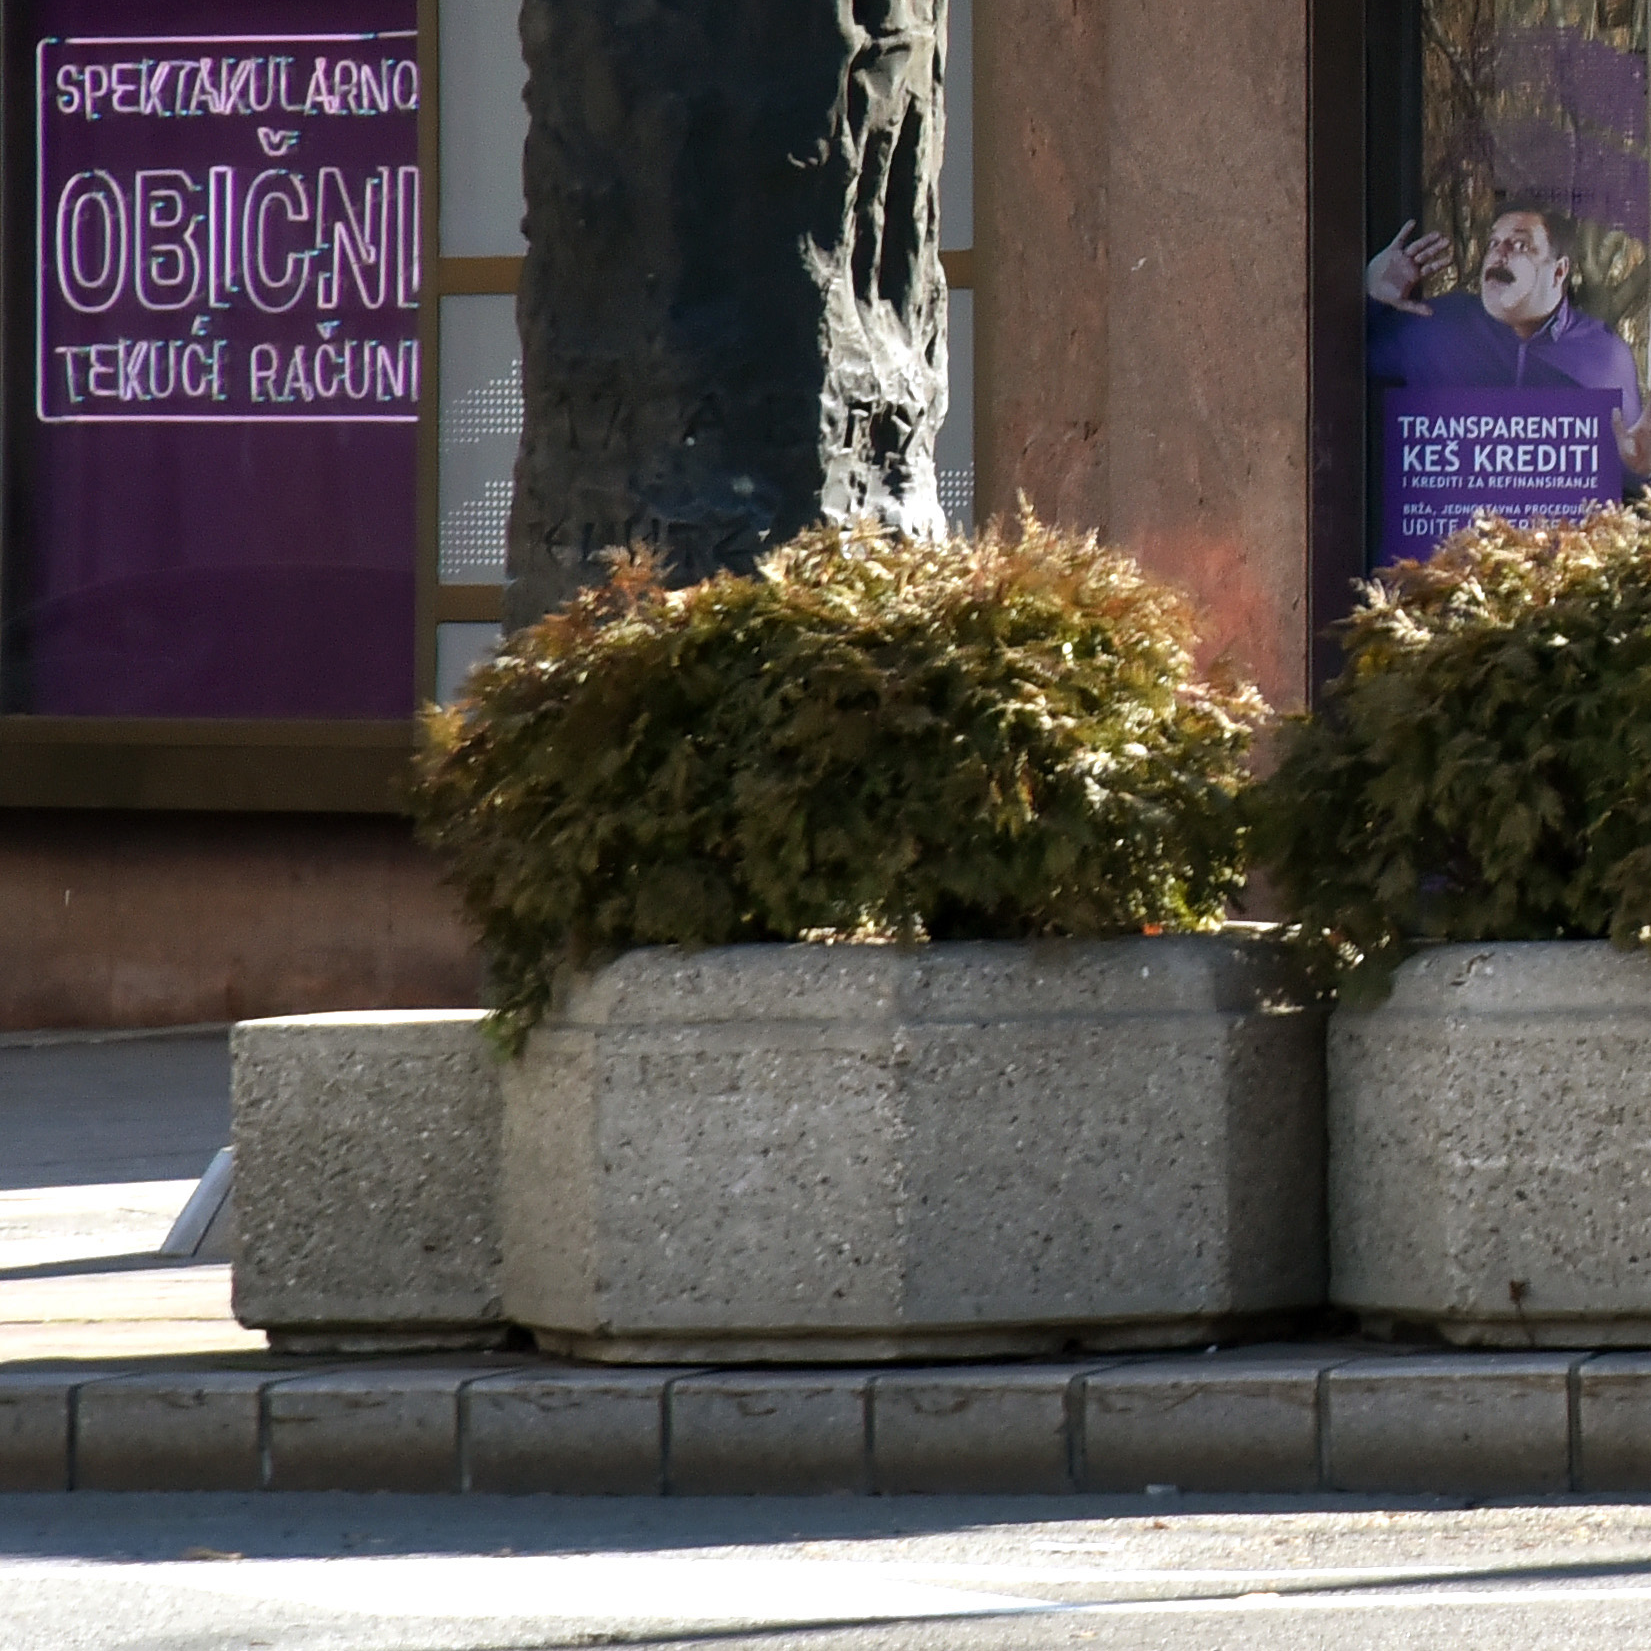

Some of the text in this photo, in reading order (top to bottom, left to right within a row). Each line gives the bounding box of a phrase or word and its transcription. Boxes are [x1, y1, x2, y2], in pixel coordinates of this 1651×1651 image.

[56, 56, 418, 121] SPEKTAKULARNO
[56, 126, 418, 314] OBIČNI
[55, 315, 418, 403] TEKUĆI RAČUNI
[1397, 415, 1599, 439] TRANSPARENTNI
[1402, 439, 1599, 473] KEŠ KREDITI
[1411, 475, 1463, 488] KREDITI
[1468, 475, 1485, 488] ZA
[1488, 475, 1599, 490] REFINANSIRANJE
[1402, 501, 1437, 517] BRŽA,
[1524, 503, 1590, 516] PROCEDUR
